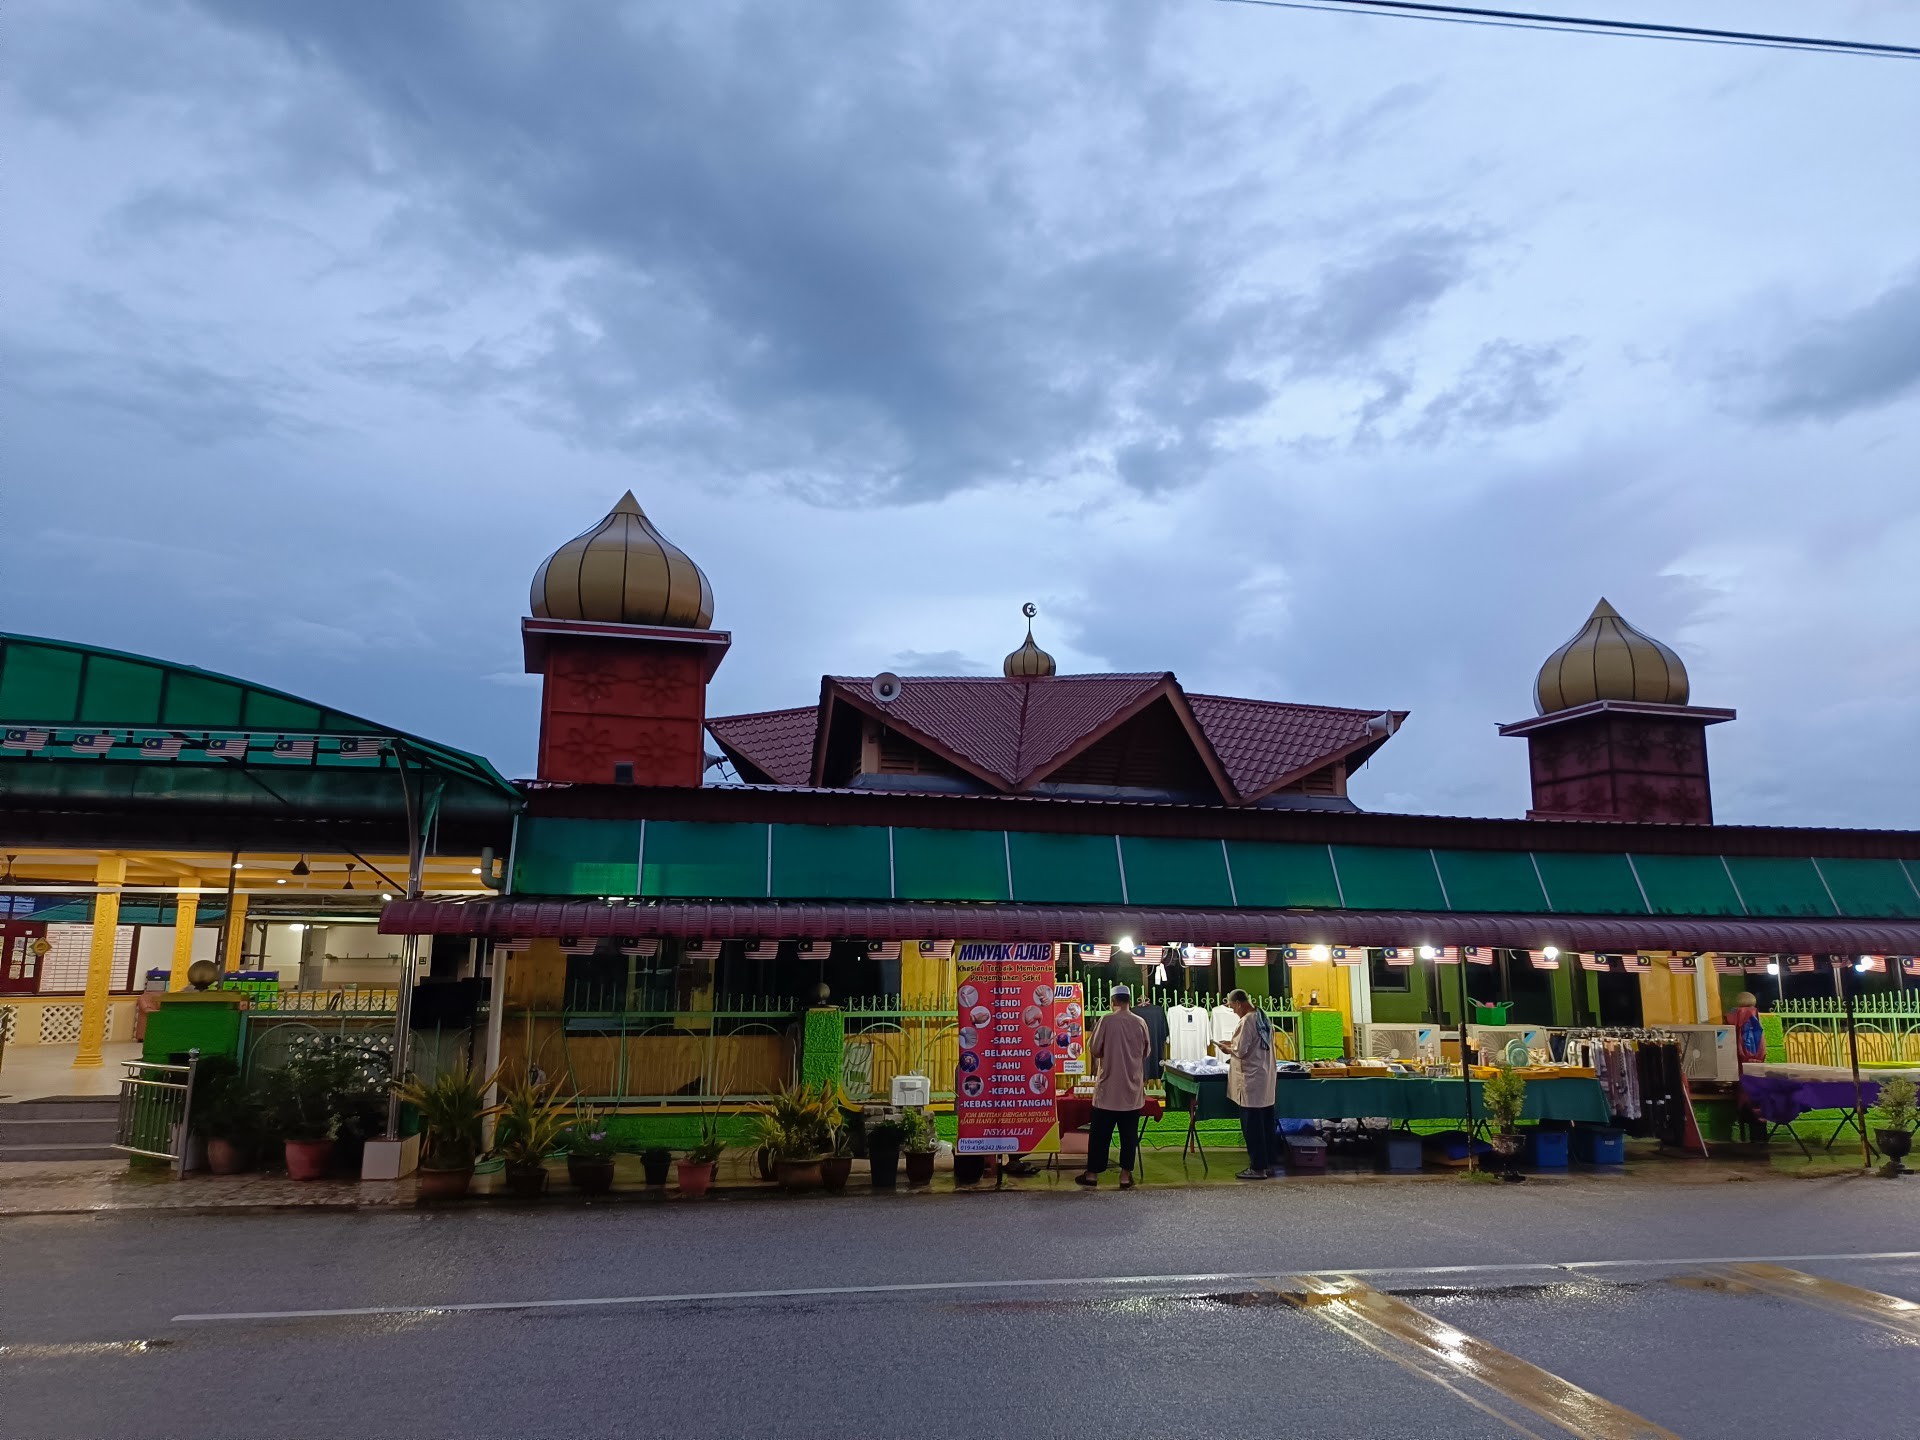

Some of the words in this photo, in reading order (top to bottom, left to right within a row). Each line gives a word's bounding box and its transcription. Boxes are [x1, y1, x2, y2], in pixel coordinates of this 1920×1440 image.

[958, 943, 1013, 961] MINYAK
[1013, 943, 1052, 961] AJAIB
[1016, 963, 1053, 972] Membantu
[990, 987, 1021, 995] -LUTUT
[1055, 985, 1073, 998] JAIB
[991, 999, 1021, 1007] -SENDI
[993, 1024, 1019, 1032] -OTOT
[990, 1036, 1022, 1044] -SARAF
[981, 1049, 1031, 1057] -BELAKANG
[992, 1062, 1021, 1070] -BAHU
[988, 1074, 1026, 1082] -STROKE
[988, 1087, 1026, 1095] -KEPALA
[960, 1100, 993, 1108] -KEBAS
[994, 1099, 1015, 1107] KAKI
[1017, 1098, 1053, 1107] TANGAN
